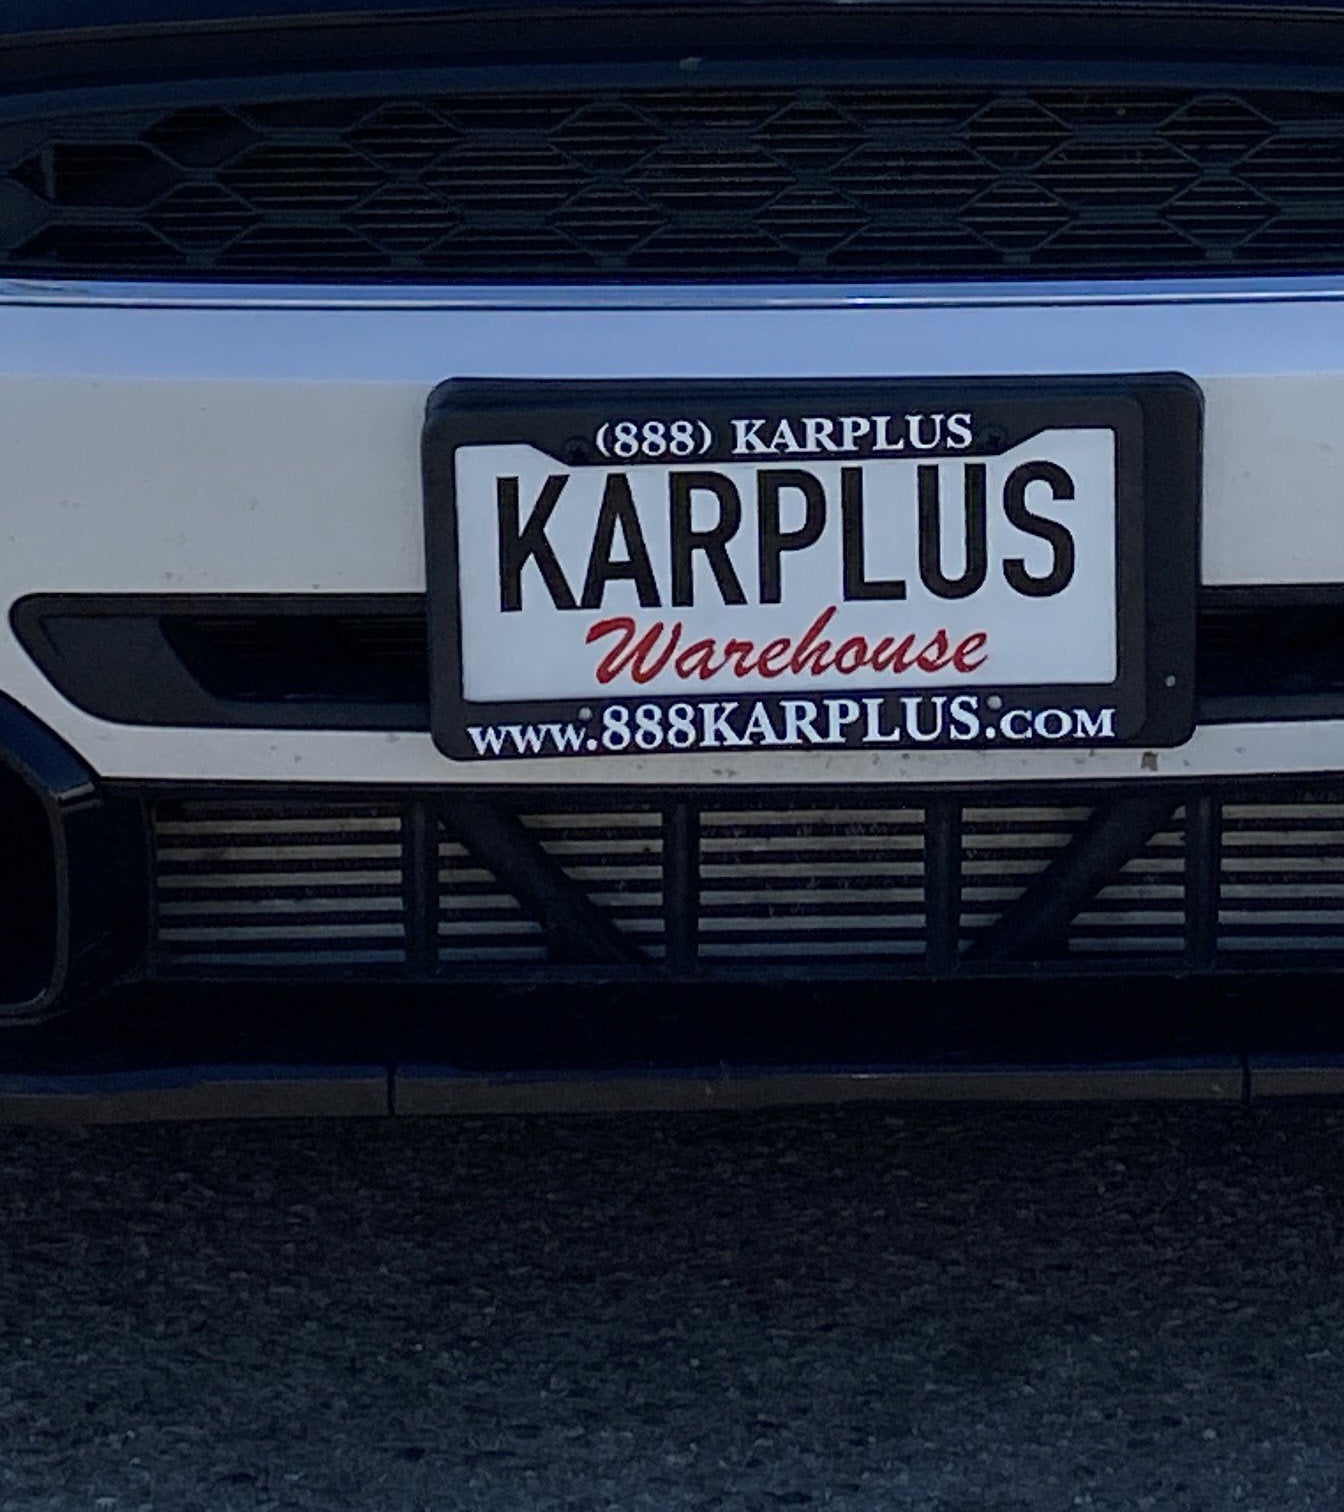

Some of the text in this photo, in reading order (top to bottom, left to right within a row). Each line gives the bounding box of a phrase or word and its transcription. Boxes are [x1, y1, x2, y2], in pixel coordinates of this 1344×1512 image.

[595, 413, 974, 460] (888) KARPLUS
[495, 460, 1077, 613] KARPLUS
[584, 605, 990, 686] Warehouse
